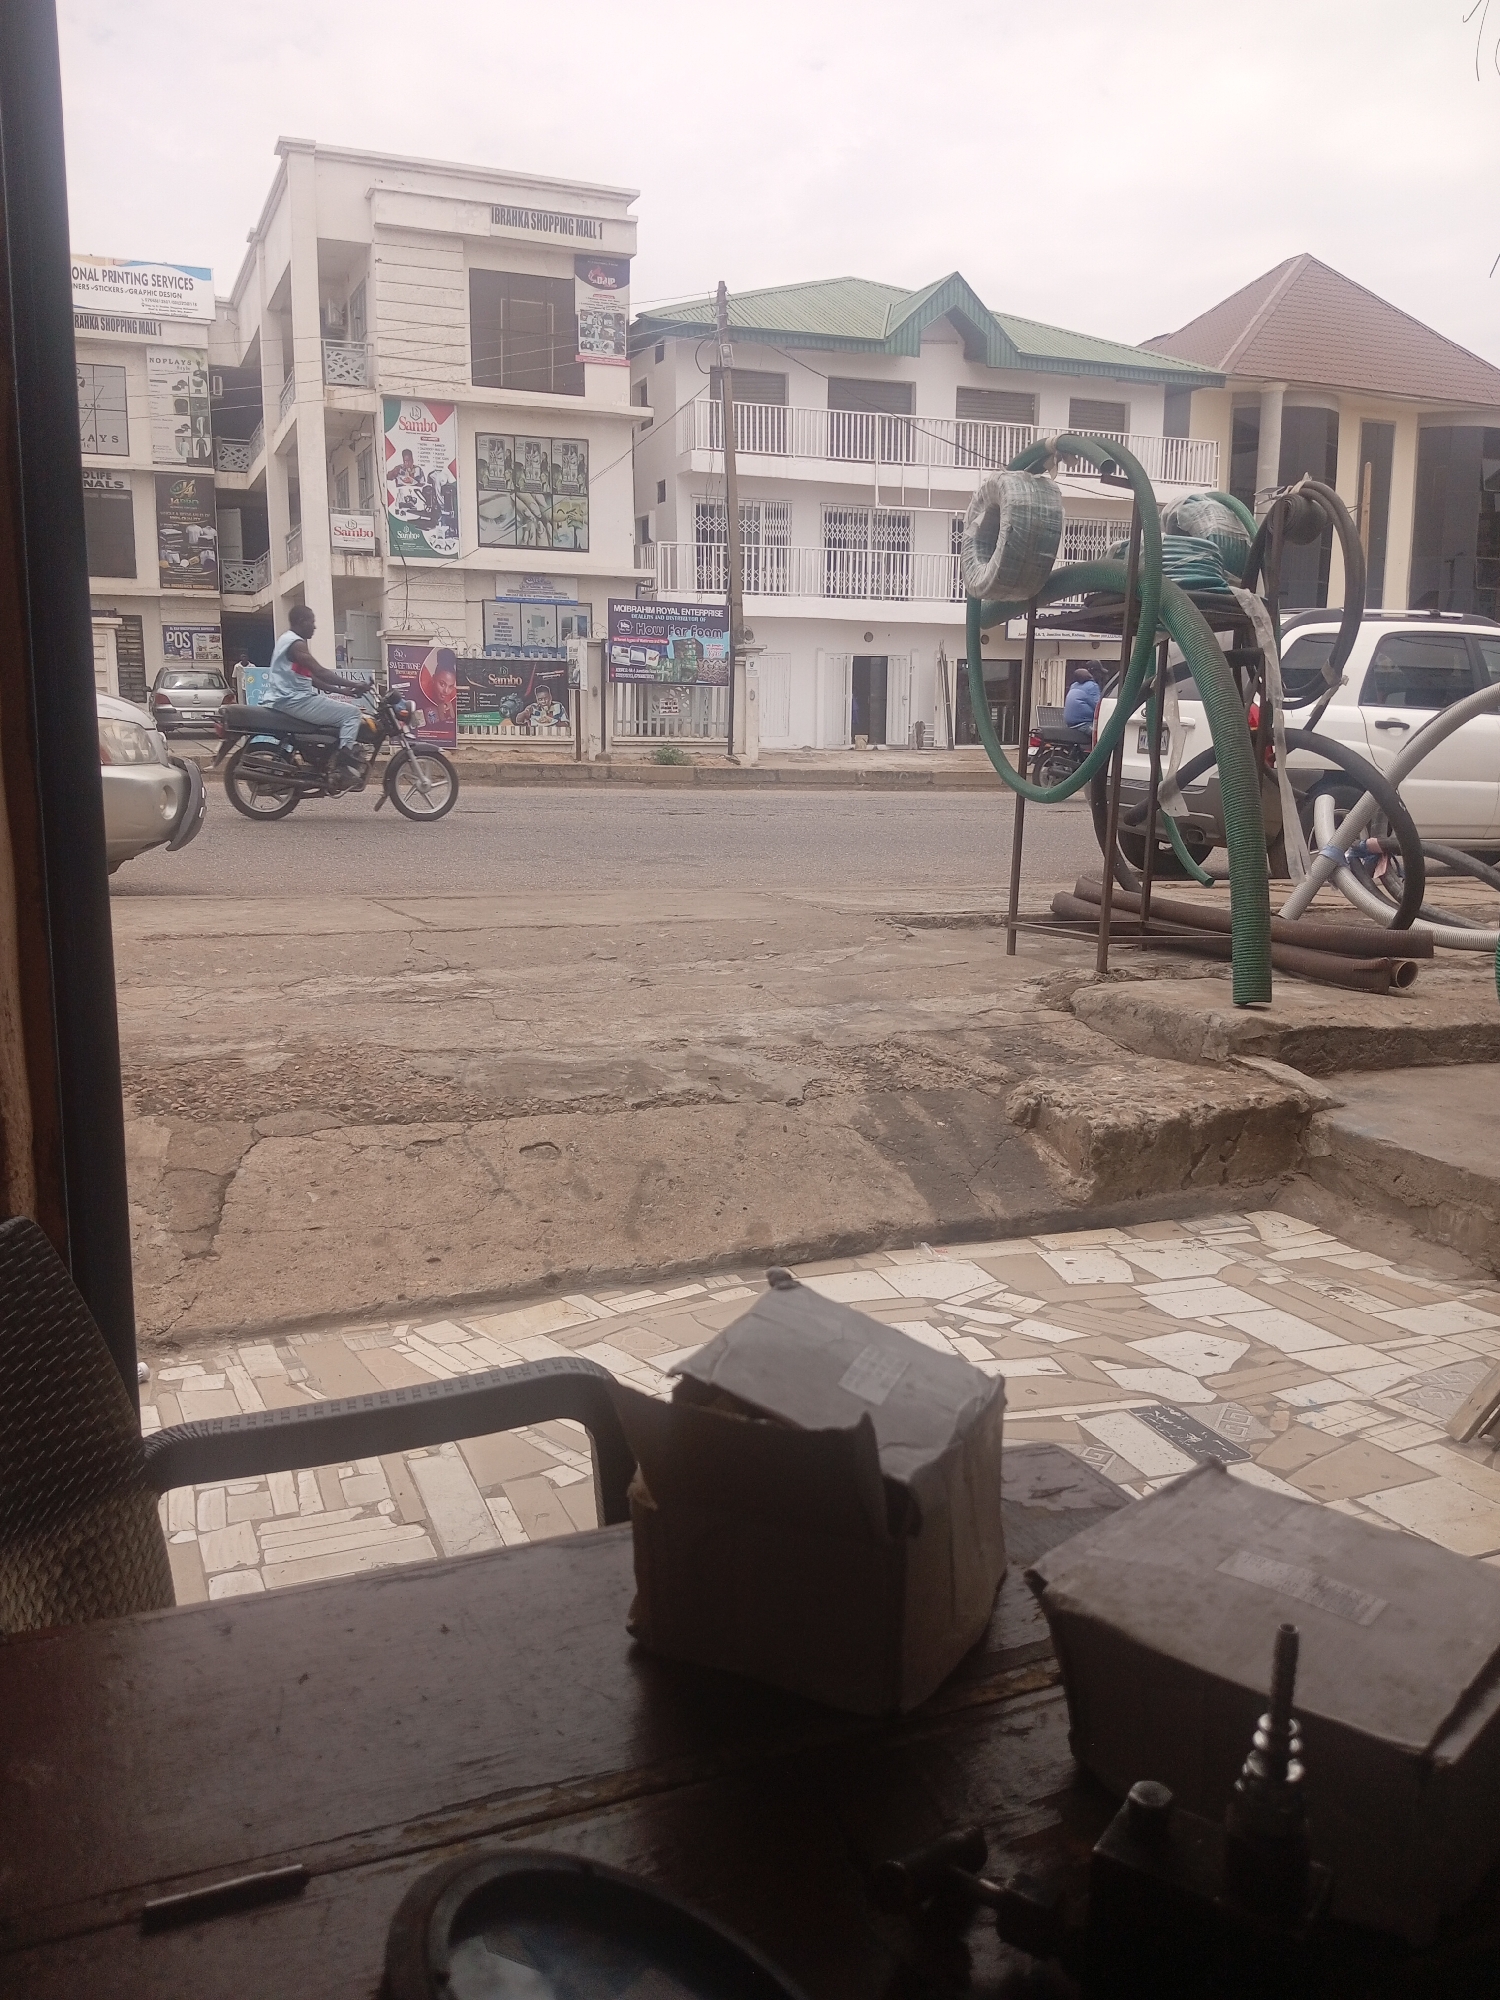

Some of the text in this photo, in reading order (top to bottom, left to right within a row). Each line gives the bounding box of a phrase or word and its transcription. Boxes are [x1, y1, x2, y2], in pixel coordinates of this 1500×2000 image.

[491, 206, 603, 240] IBRAHKA SHOPPING MALL 1
[102, 269, 149, 287] PRINTING
[151, 273, 194, 291] SERVICES
[95, 284, 124, 294] STICKERS
[128, 288, 157, 297] GRAPHIC
[158, 290, 182, 299] DESIGN
[100, 317, 138, 334] SHOPPING
[138, 321, 157, 336] MALL
[157, 322, 162, 337] 1
[149, 357, 192, 366] NOPLAYS
[398, 415, 438, 433] Sambo
[333, 526, 374, 538] Sambo
[397, 531, 418, 539] Sambo
[656, 606, 680, 616] ROYAL
[681, 607, 724, 618] ENTERPRISE
[636, 622, 665, 636] How
[166, 631, 191, 648] POS
[488, 673, 523, 685] Sambo
